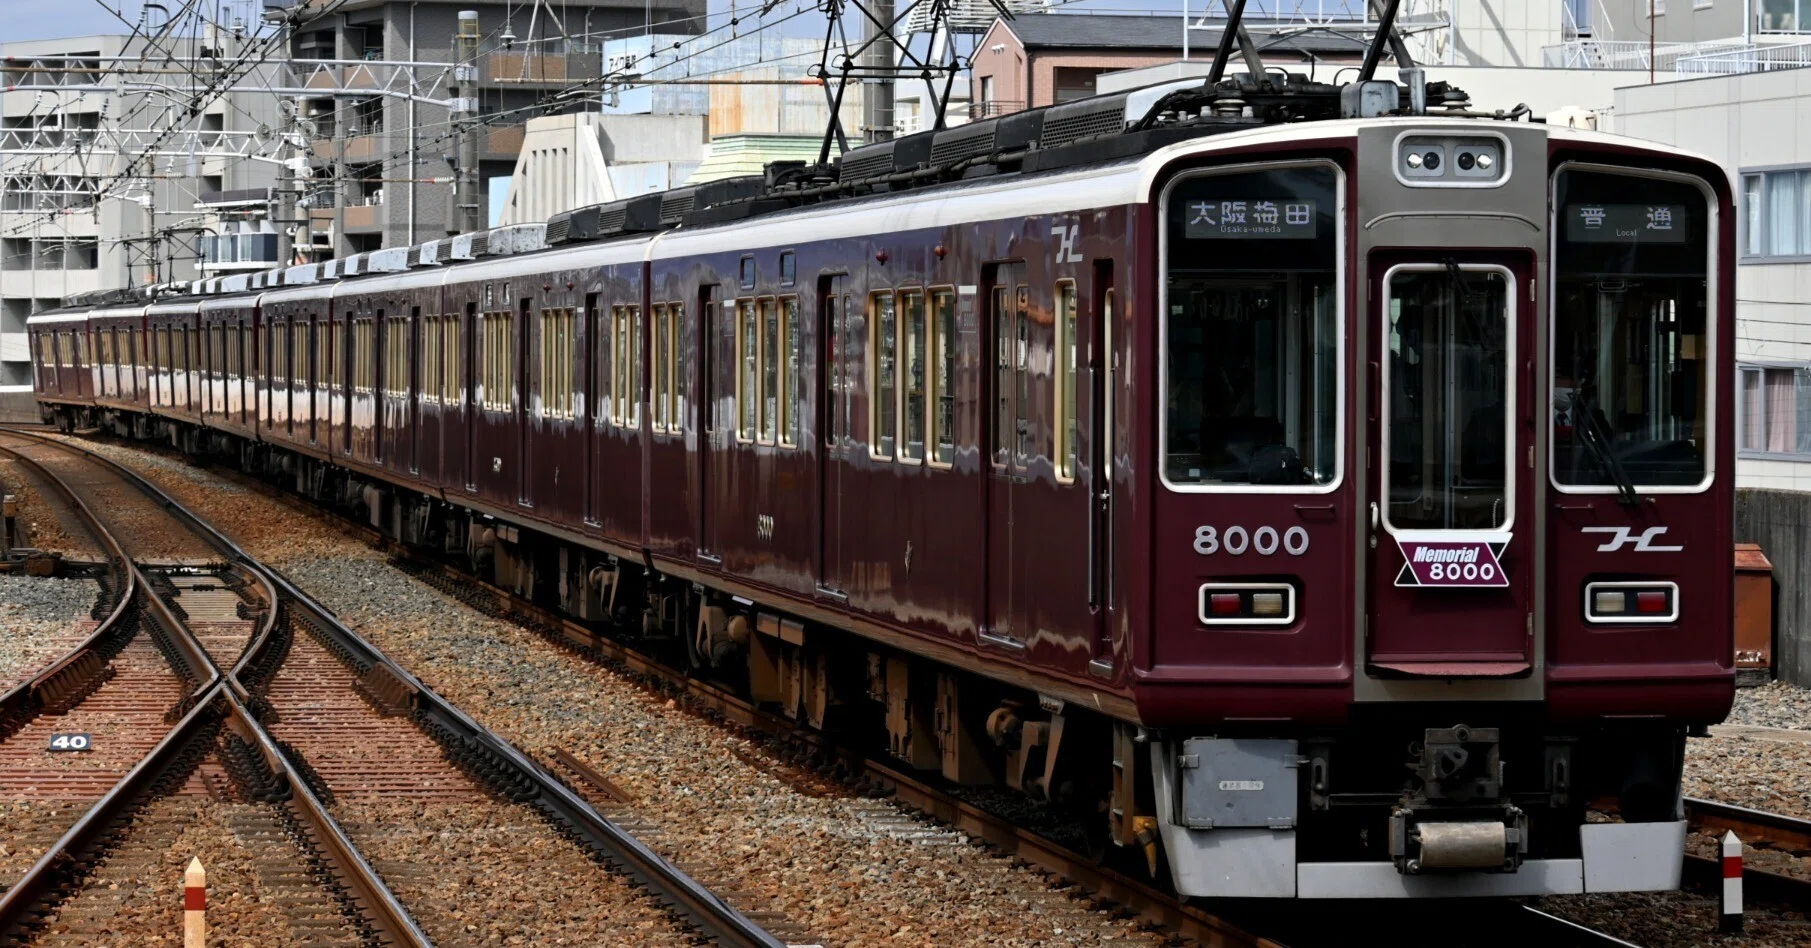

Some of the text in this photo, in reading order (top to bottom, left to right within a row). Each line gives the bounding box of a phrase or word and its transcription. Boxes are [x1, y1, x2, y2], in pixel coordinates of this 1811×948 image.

[1190, 201, 1310, 225] 大阪梅田
[1580, 205, 1673, 230] 普通
[1220, 225, 1281, 233] Osaka-umeda
[1616, 229, 1637, 237] Local
[1193, 525, 1310, 556] 8000
[1413, 546, 1480, 563] Memorial
[1429, 563, 1495, 580] 8000
[52, 735, 87, 749] 40
